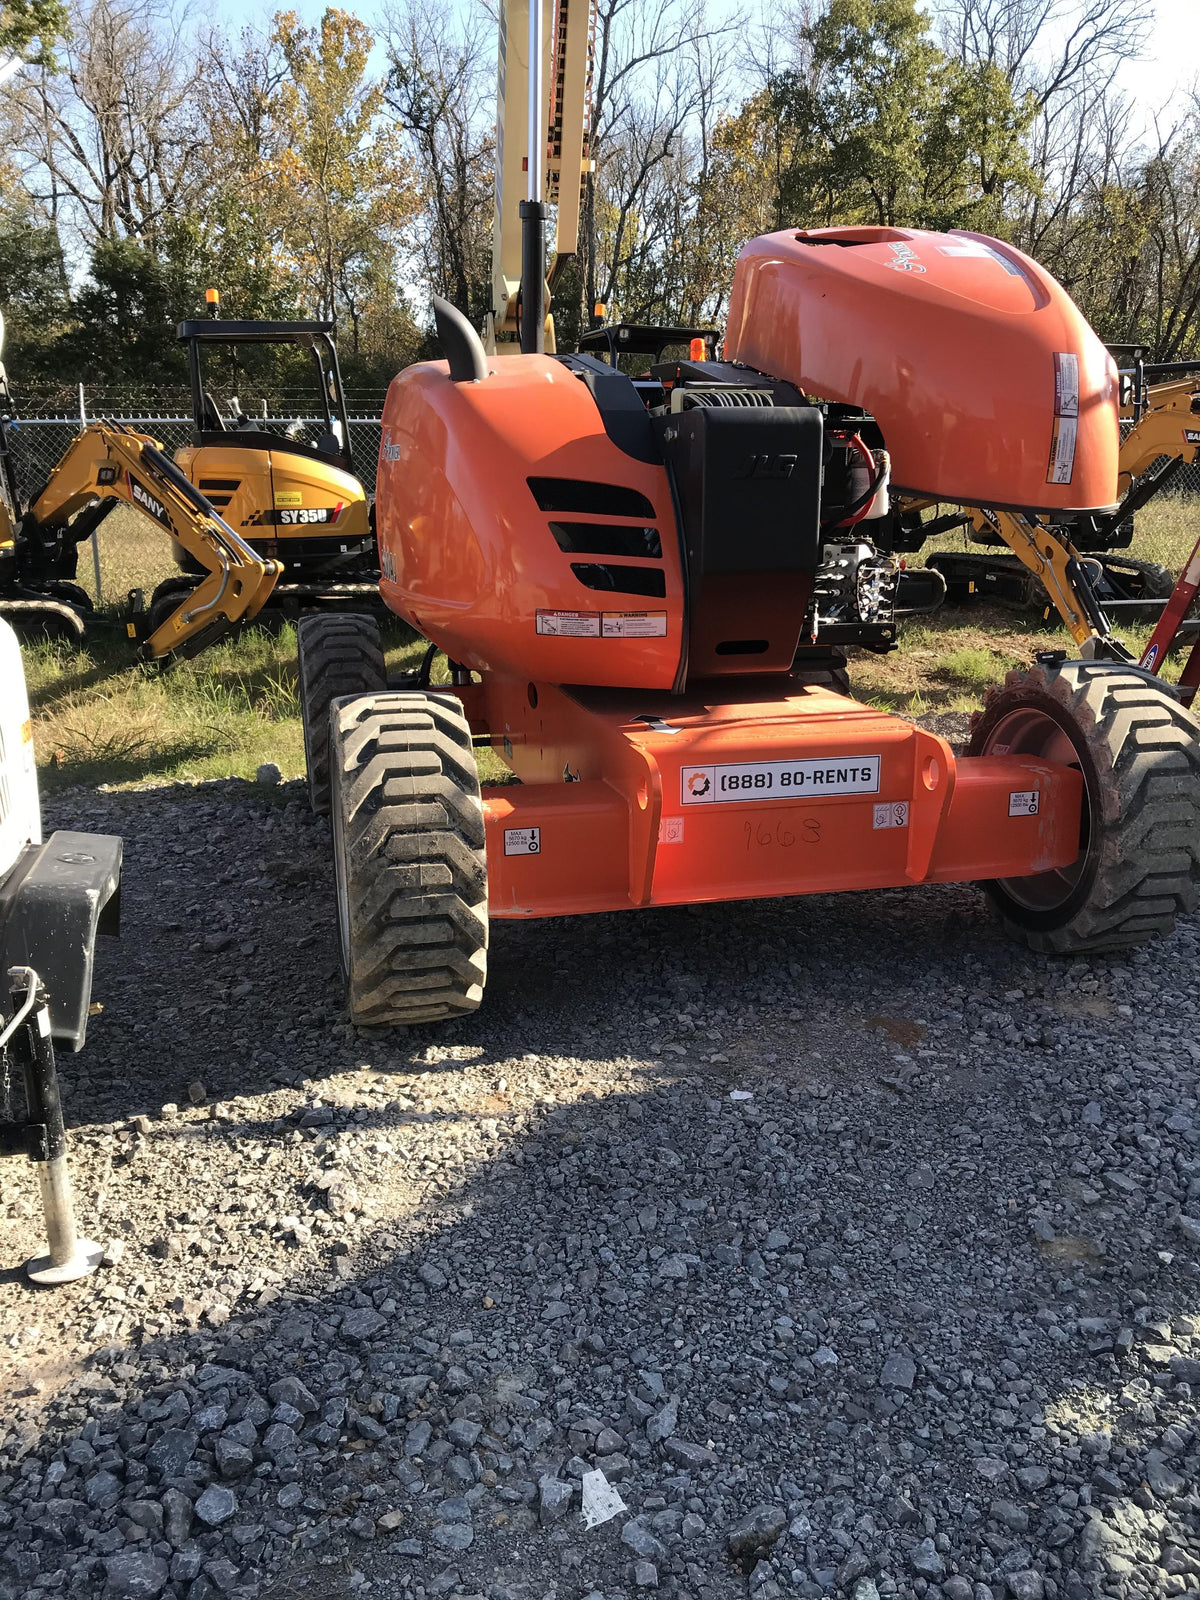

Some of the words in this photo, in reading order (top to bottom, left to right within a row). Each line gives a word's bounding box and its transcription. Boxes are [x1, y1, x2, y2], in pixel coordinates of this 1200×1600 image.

[133, 484, 164, 517] SANY
[280, 508, 327, 523] SY35U
[721, 772, 773, 791] (888)
[780, 767, 872, 786] 80-RENTS
